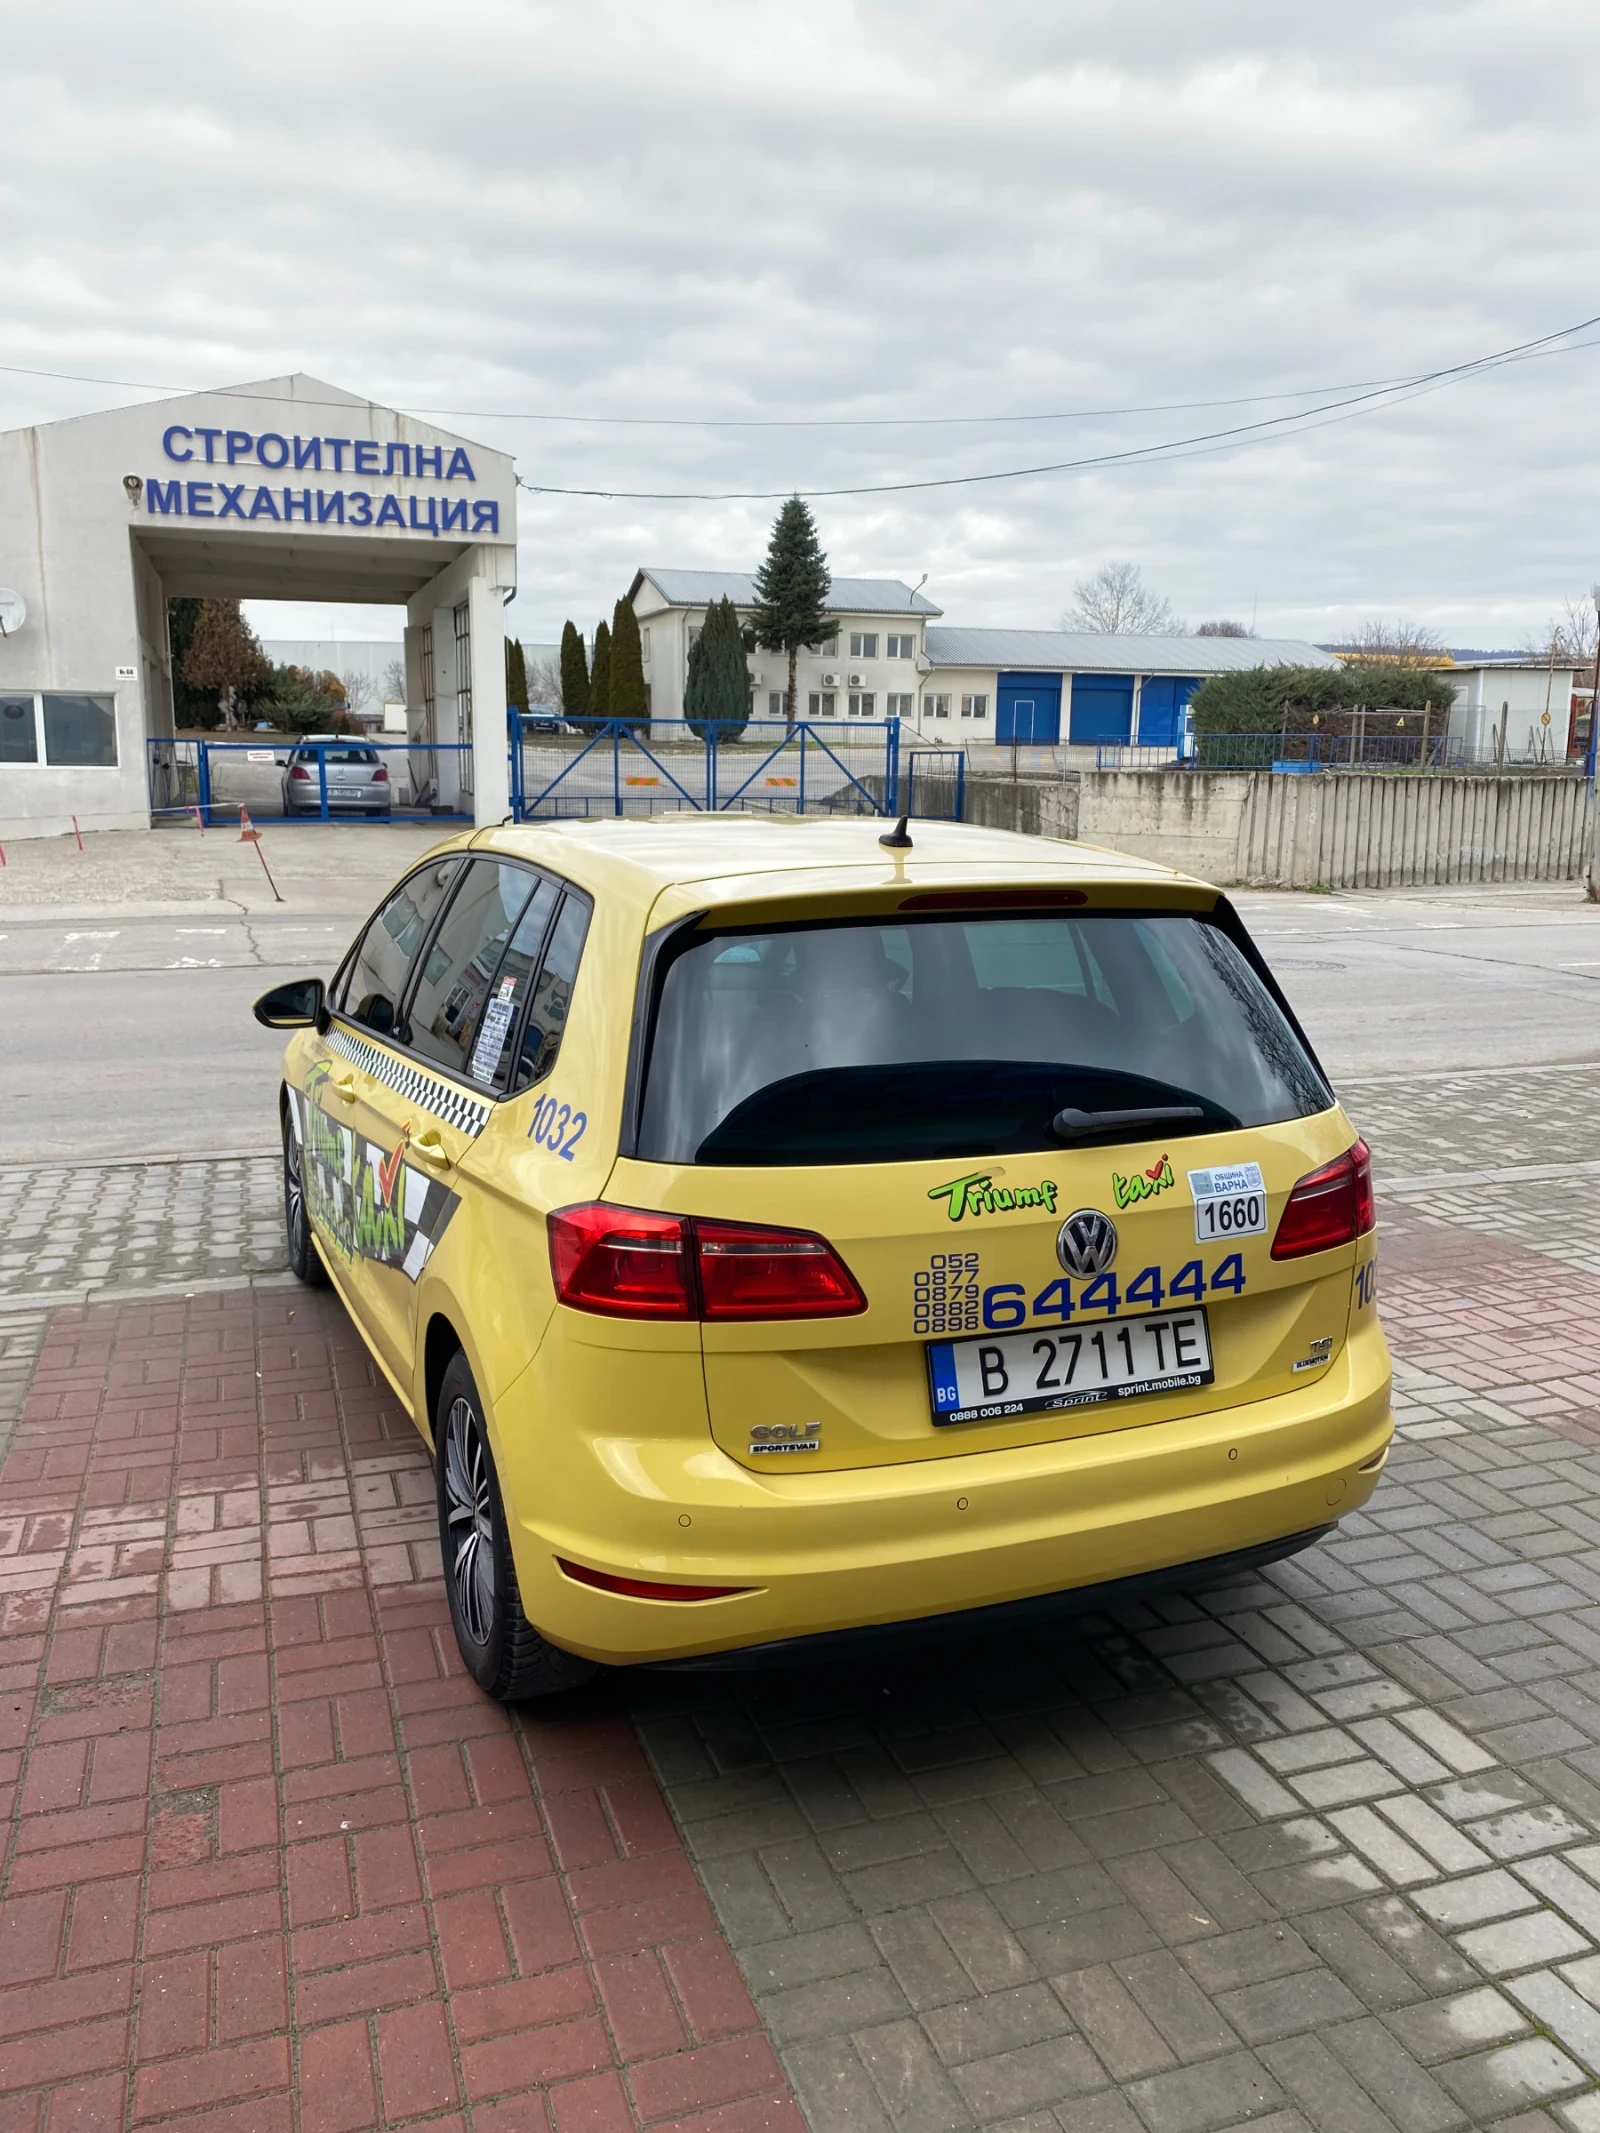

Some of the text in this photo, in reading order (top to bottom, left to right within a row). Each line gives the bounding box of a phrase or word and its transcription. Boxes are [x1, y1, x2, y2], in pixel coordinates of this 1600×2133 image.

[163, 425, 476, 481] СТРОИТЕЛНА
[146, 478, 499, 537] МЕХАНИЗАЦИЯ
[527, 1093, 587, 1162] 1032
[1214, 1171, 1244, 1181] ОБЩИНА
[928, 1153, 1174, 1222] Triumf taxi
[1214, 1179, 1249, 1193] ВАРНА
[1205, 1196, 1260, 1233] 1660
[931, 1253, 979, 1269] 052
[914, 1269, 979, 1286] 0877
[1355, 1260, 1377, 1310] 10
[914, 1284, 979, 1302] 0879
[982, 1253, 1246, 1330] 644444
[914, 1300, 979, 1318] 0882
[913, 1316, 979, 1334] 0898
[978, 1319, 1201, 1397] B 2711 TE
[1118, 1374, 1202, 1397] sprint.mobile.bg
[937, 1386, 957, 1404] BG
[1052, 1393, 1102, 1408] Sprint
[949, 1409, 978, 1422] 0888
[1004, 1403, 1024, 1415] 224
[750, 1422, 821, 1438] GOLF
[752, 1443, 816, 1453] SPORTSVAN
